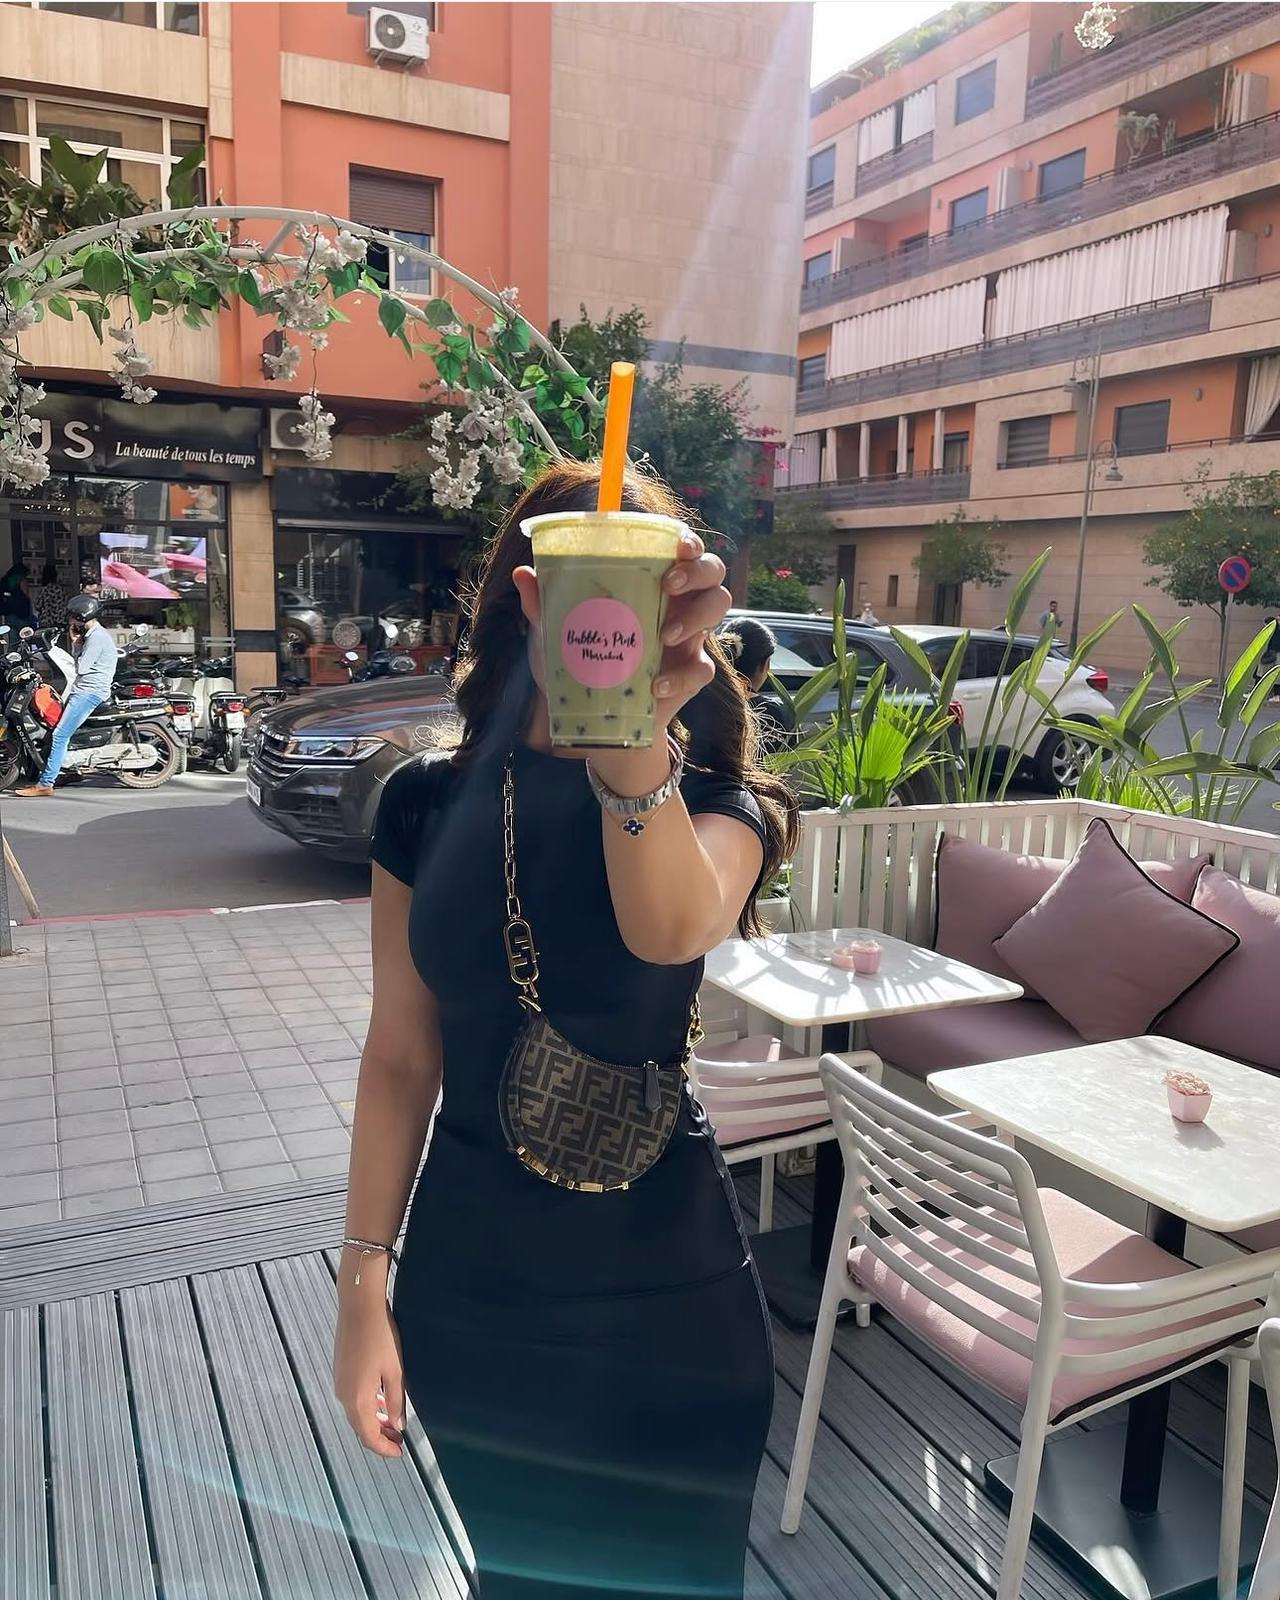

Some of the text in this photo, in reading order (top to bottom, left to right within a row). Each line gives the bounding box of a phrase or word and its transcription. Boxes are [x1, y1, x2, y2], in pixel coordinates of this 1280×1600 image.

[115, 441, 256, 469] La beauté de tous les temps
